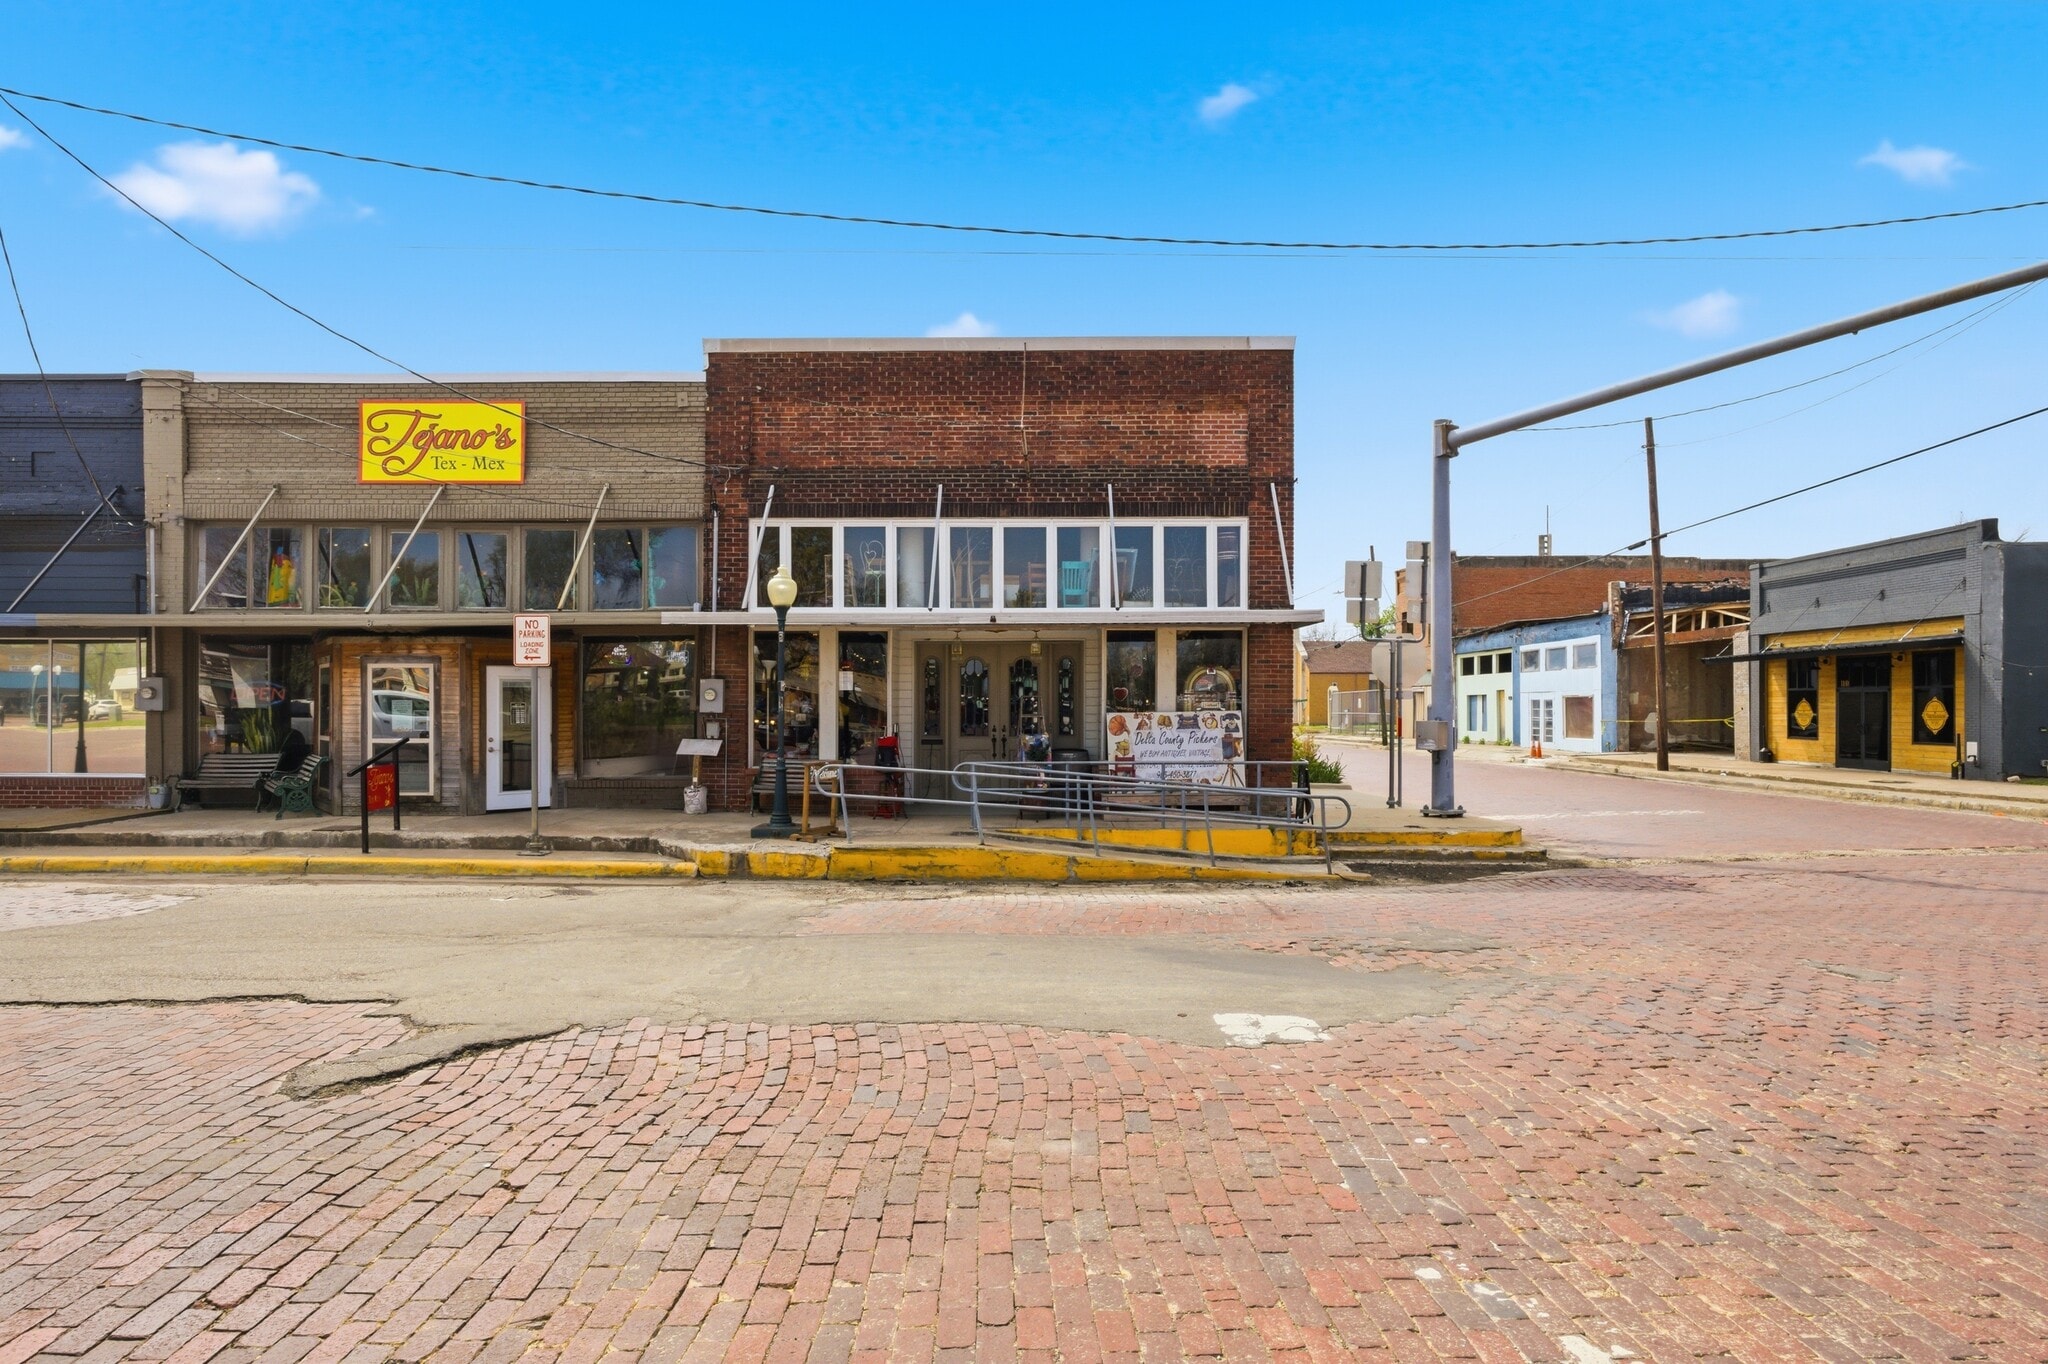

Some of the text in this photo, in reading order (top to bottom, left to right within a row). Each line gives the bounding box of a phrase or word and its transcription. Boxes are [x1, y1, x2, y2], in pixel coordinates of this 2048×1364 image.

[366, 409, 517, 477] Tejano's
[431, 456, 457, 470] Tex
[472, 456, 505, 470] Mex
[525, 620, 539, 629] NO
[519, 630, 545, 639] PARKING
[230, 687, 287, 701] OPEN
[1135, 731, 1218, 749] Delta County Pickers
